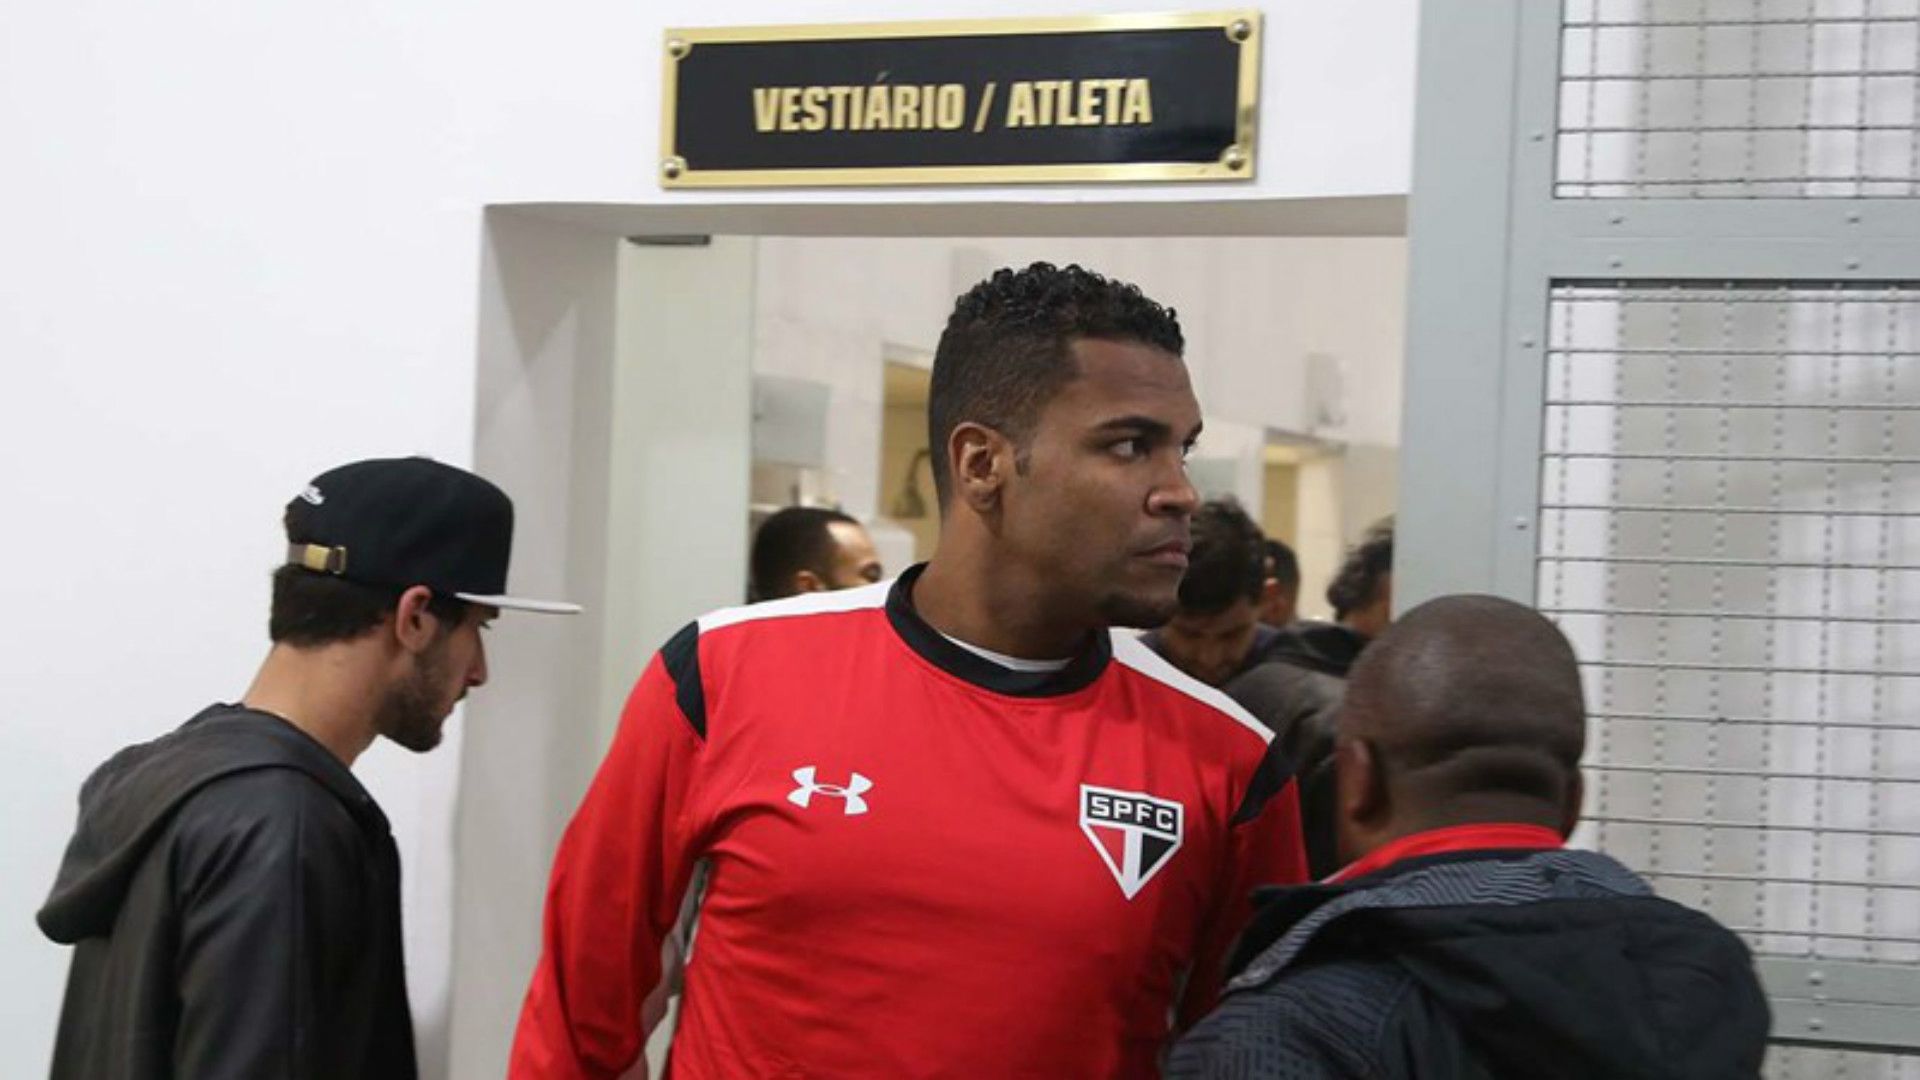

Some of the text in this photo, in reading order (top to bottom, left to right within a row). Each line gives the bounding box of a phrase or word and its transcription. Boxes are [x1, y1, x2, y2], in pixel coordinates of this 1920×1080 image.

[752, 71, 1153, 134] VESTIÁRIO / ATLETA
[1090, 795, 1174, 831] SPFC
